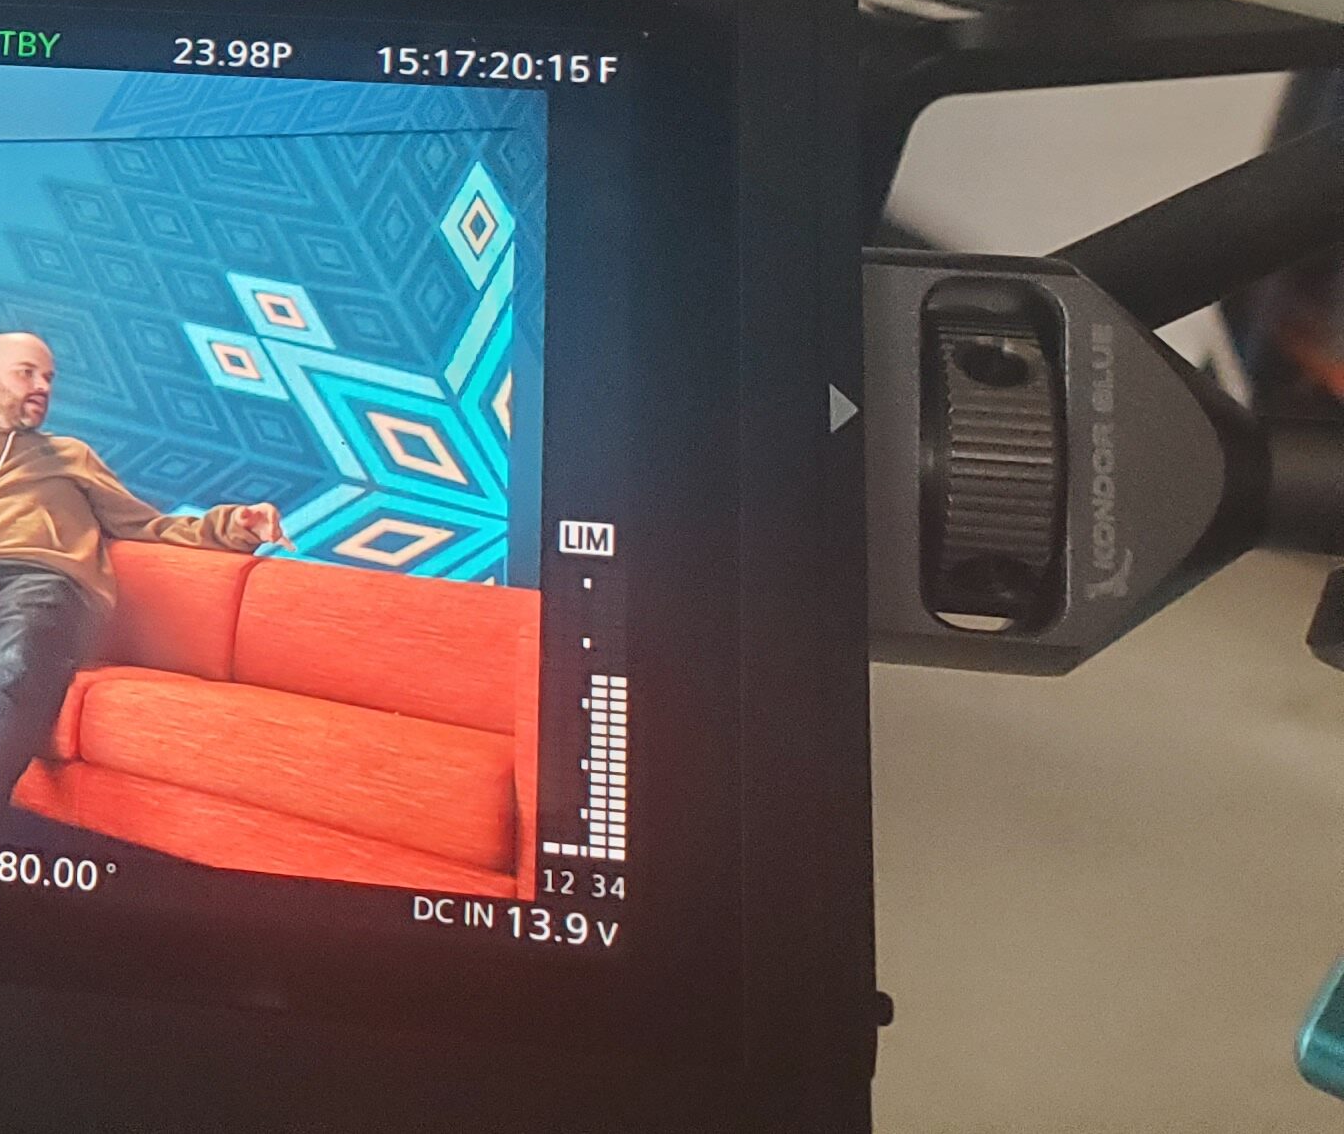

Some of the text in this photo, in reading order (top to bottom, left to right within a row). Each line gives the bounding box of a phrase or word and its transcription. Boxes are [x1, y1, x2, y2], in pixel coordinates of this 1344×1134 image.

[172, 37, 293, 69] 23.98P
[377, 46, 592, 84] 15:17:20:15
[1092, 323, 1116, 570] KONDOR BLUE
[564, 524, 609, 552] LIM
[413, 896, 619, 948] DC IN 13.9 V
